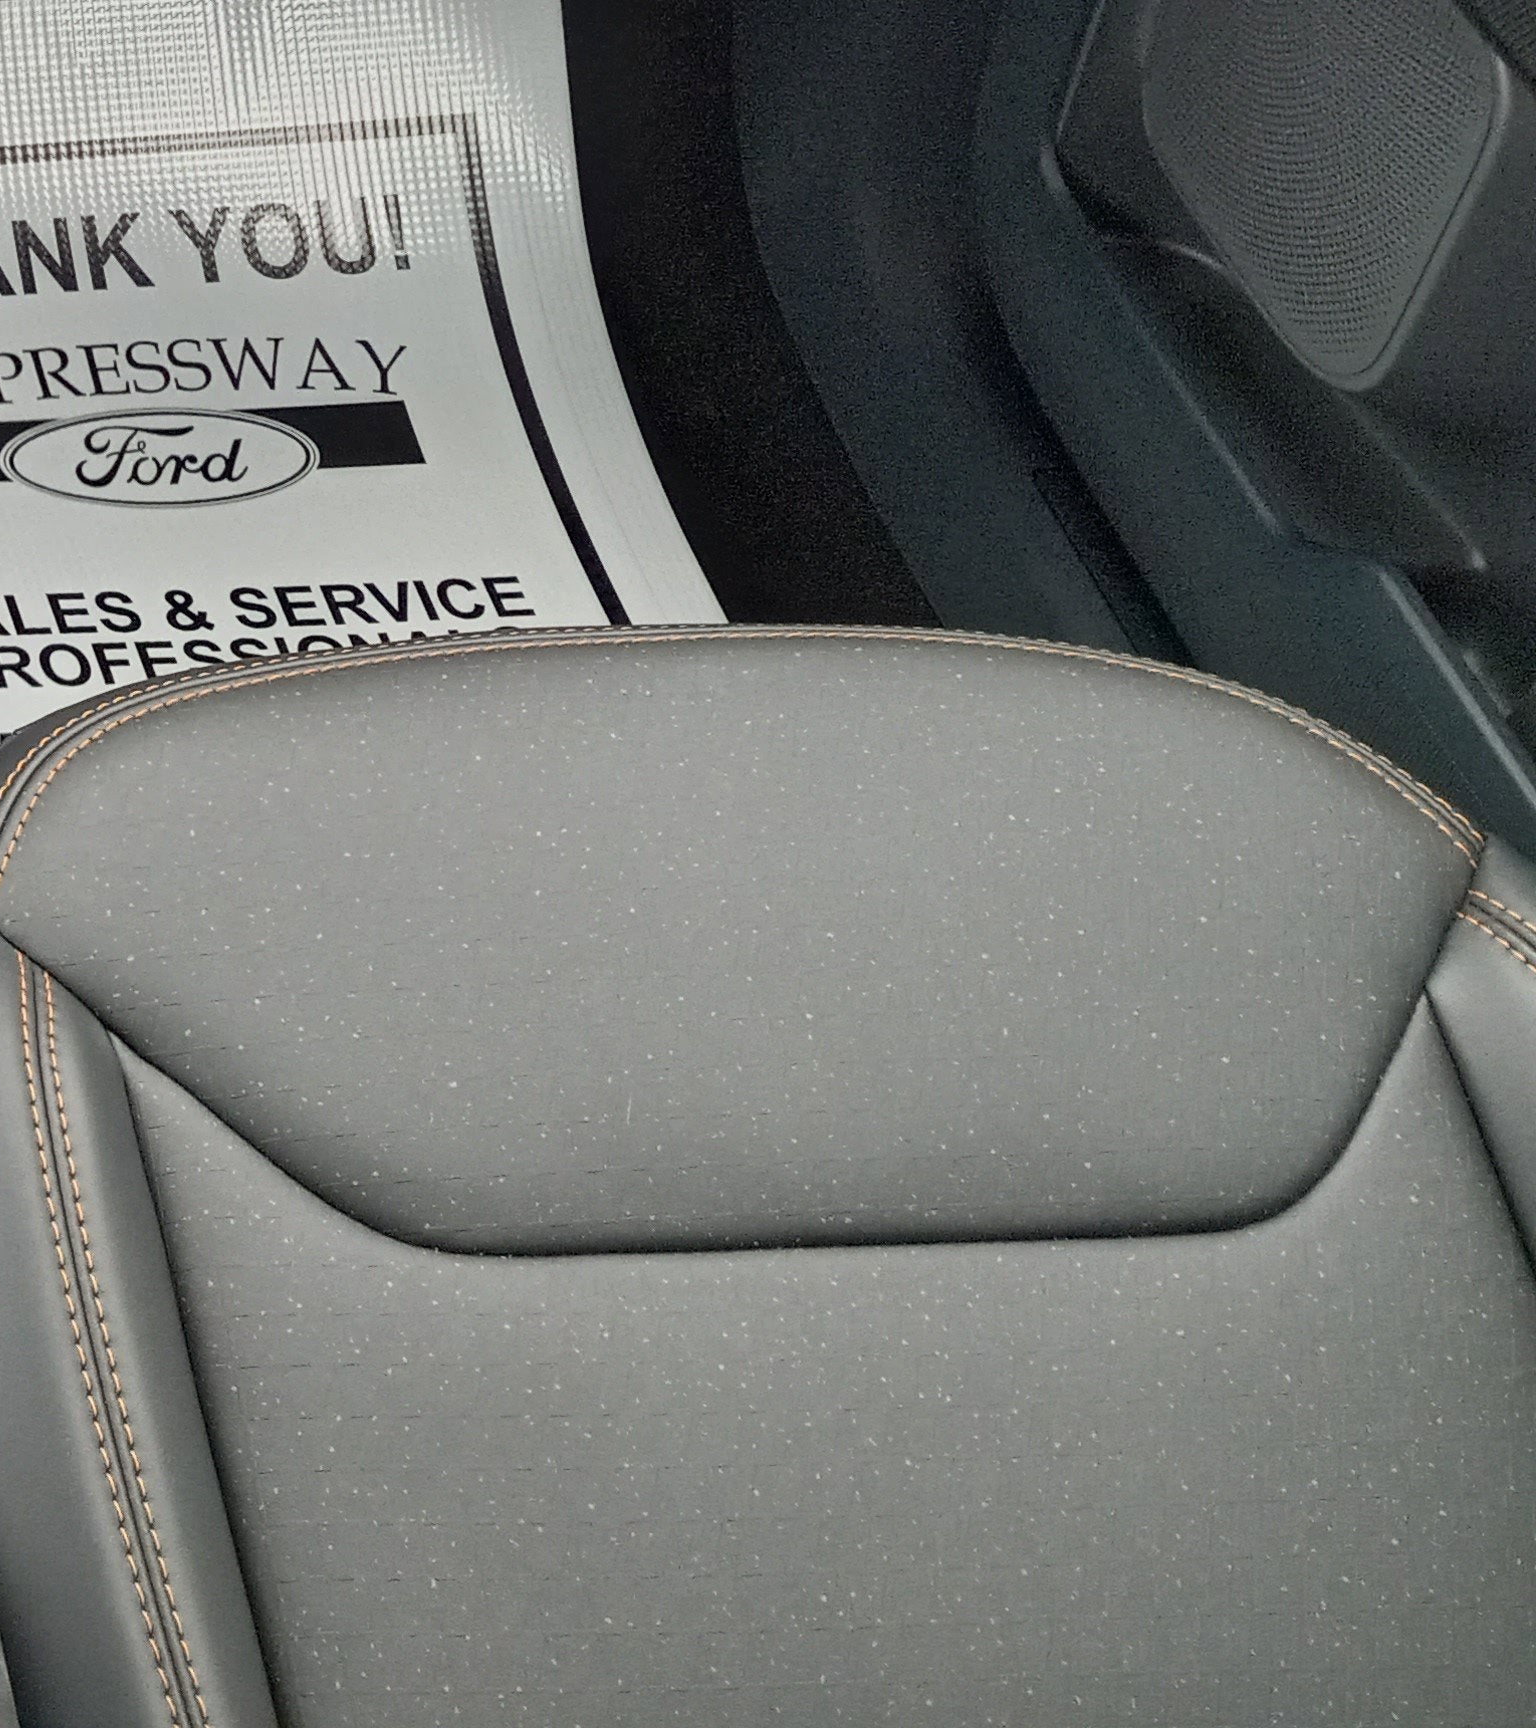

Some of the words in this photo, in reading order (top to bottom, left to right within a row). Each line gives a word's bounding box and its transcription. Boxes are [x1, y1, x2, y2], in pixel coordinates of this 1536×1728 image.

[166, 192, 412, 283] YOU!
[75, 424, 249, 486] Ford
[165, 589, 216, 632] &
[228, 575, 535, 631] SERVICE
